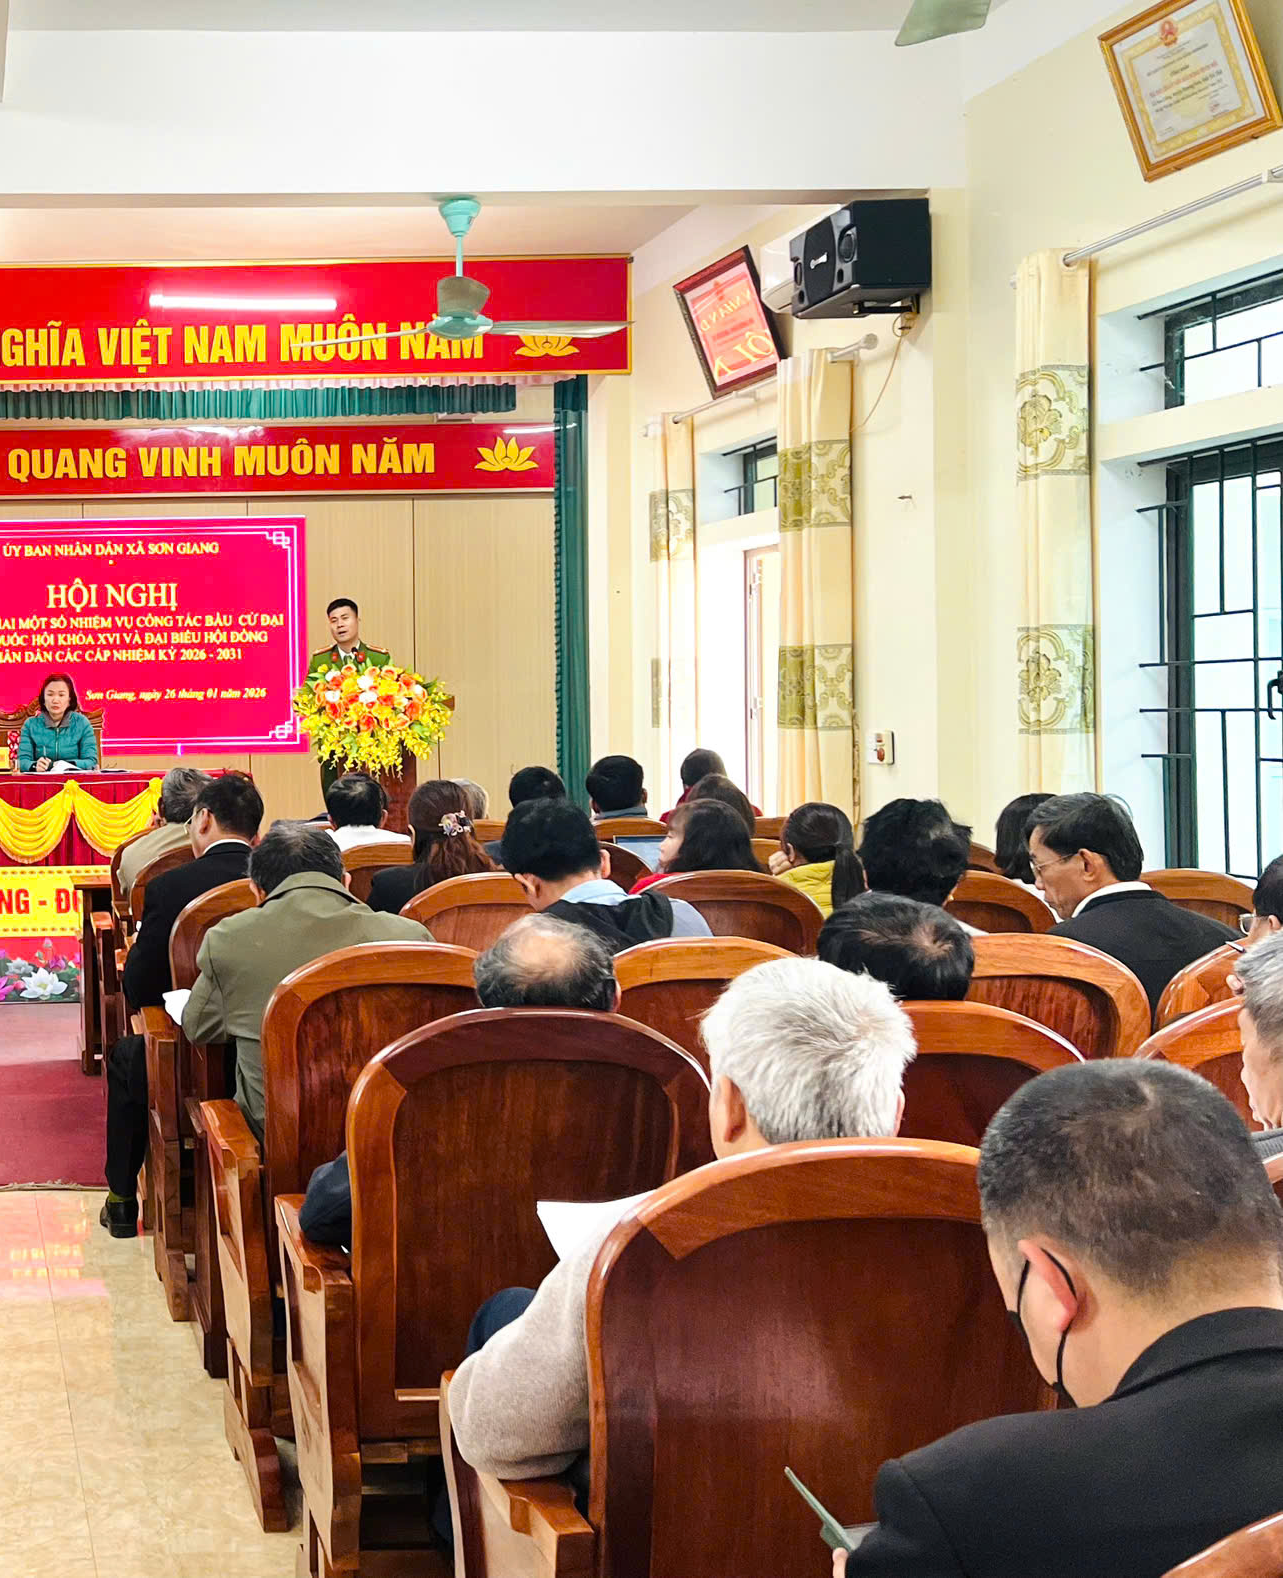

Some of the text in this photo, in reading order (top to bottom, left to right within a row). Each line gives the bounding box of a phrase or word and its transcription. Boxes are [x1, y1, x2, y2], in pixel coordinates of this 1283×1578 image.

[98, 318, 173, 374] VIỆT
[184, 324, 267, 364] NAM
[280, 313, 388, 362] MUÔN
[8, 447, 127, 483] QUANG
[139, 446, 222, 477] VINH
[233, 438, 340, 476] MUÔN
[351, 437, 436, 475] NĂM
[24, 544, 52, 557] BAN
[55, 542, 93, 556] NHÂN
[95, 541, 124, 556] DÂN
[148, 542, 174, 555] SƠN
[177, 541, 220, 555] GIANG
[46, 577, 178, 613] HỘI NGHỊ
[18, 615, 48, 631] MỘT
[70, 615, 113, 630] NHIỆM
[115, 615, 134, 630] VỤ
[136, 613, 174, 627] CÔNG
[176, 613, 203, 627] TÁC
[260, 613, 284, 628] ĐẠI
[31, 631, 55, 648] HỘI
[57, 631, 96, 646] KHÓA
[97, 632, 120, 645] XVI
[122, 630, 142, 645] VÀ
[144, 632, 168, 646] ĐẠI
[204, 629, 228, 645] HỘI
[24, 649, 53, 663] DÂN
[55, 648, 83, 663] CÁC
[113, 648, 156, 663] NHIỆM
[180, 648, 207, 661] 2026
[216, 647, 242, 660] 2031
[164, 688, 176, 699] 26
[206, 687, 218, 699] 01
[243, 687, 267, 699] 2026
